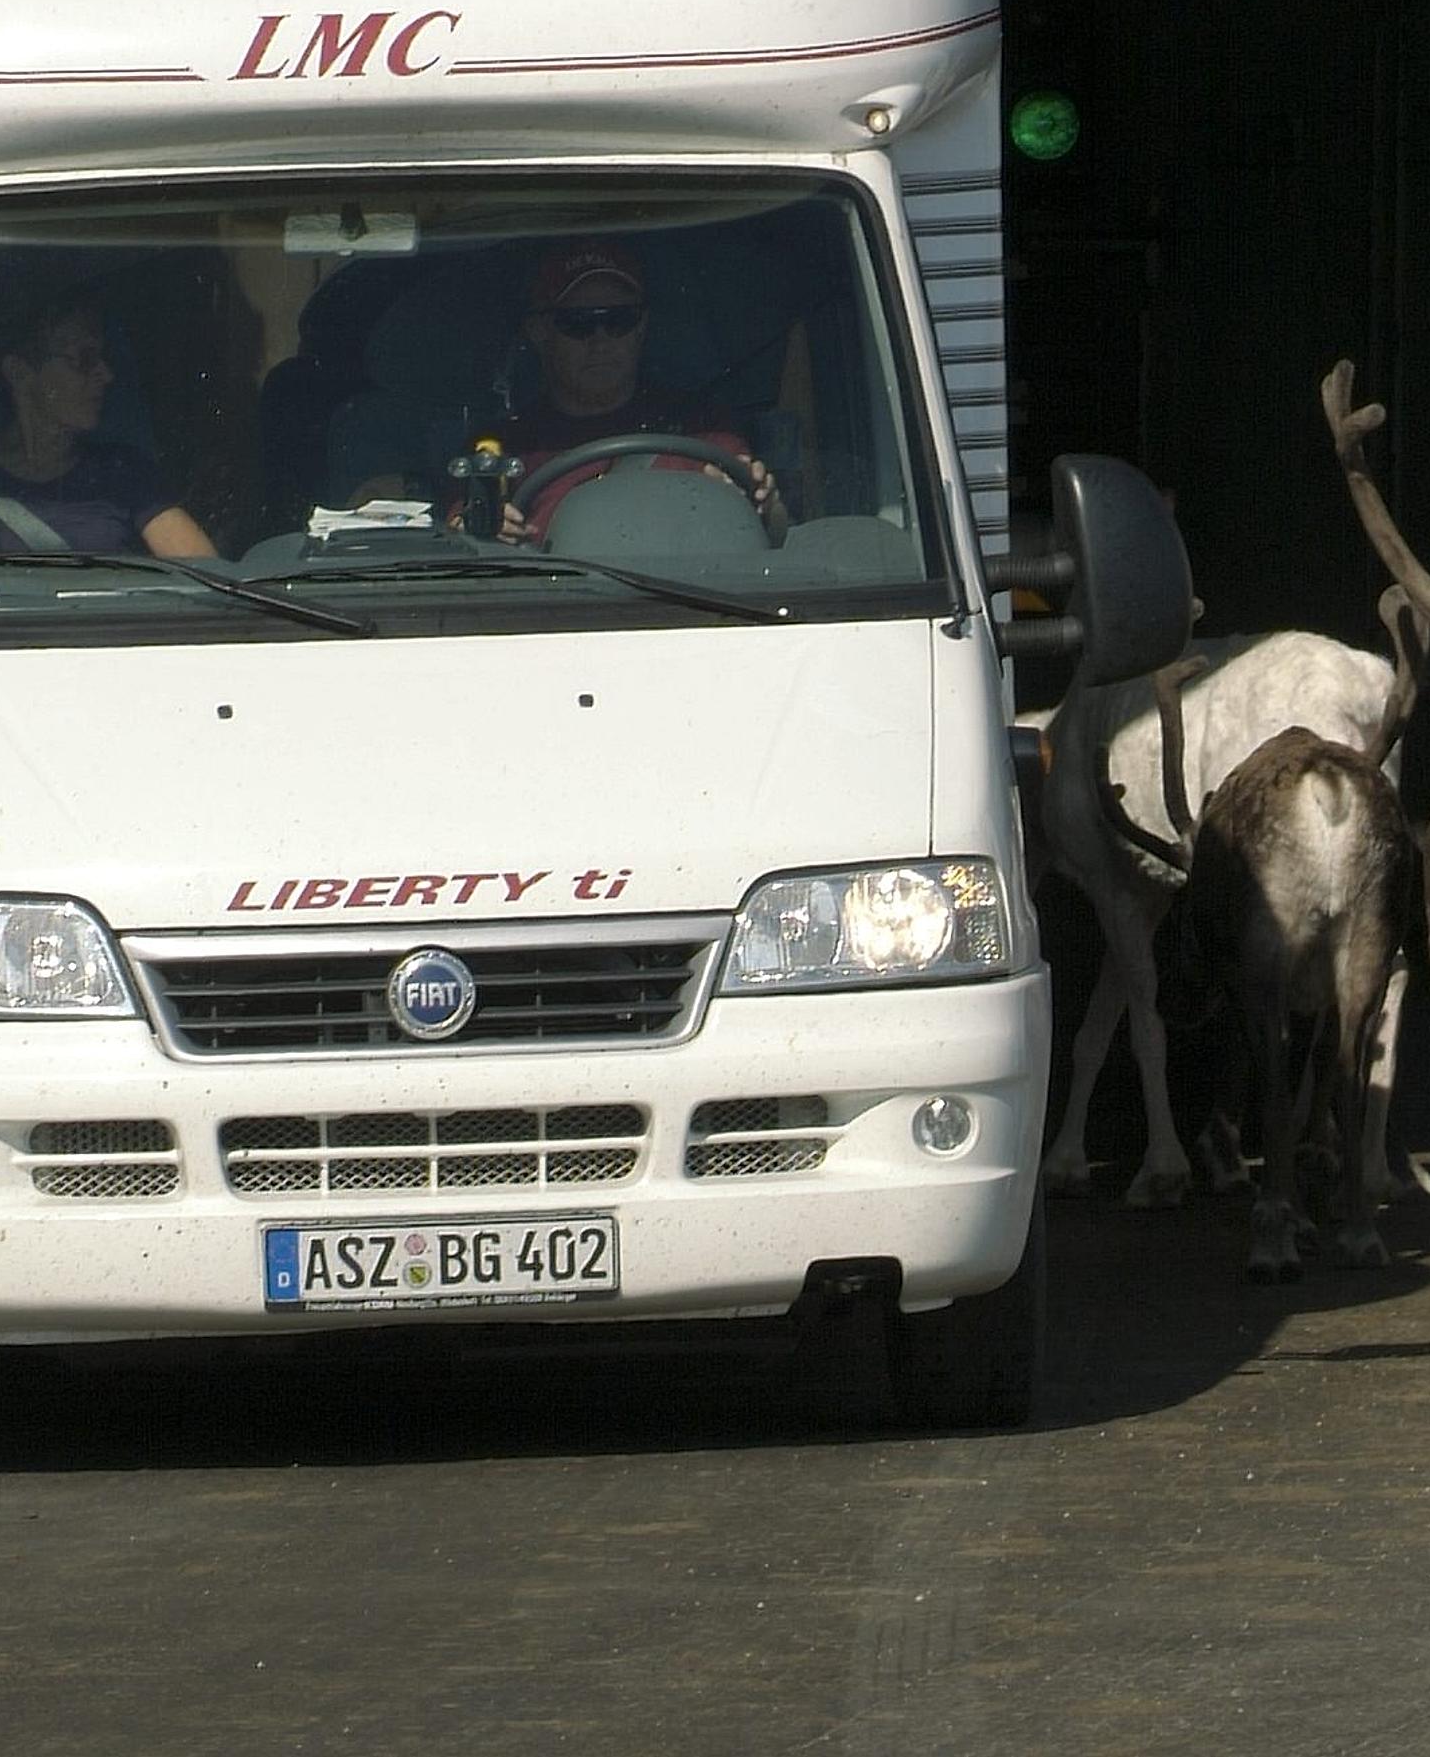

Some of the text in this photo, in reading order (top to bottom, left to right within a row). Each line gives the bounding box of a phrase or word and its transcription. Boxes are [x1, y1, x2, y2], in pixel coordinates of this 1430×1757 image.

[226, 9, 463, 81] LMC
[226, 868, 633, 912] LIBERTY ti
[406, 982, 458, 1009] FIAT
[277, 1227, 609, 1292] D ASZ BG 402
